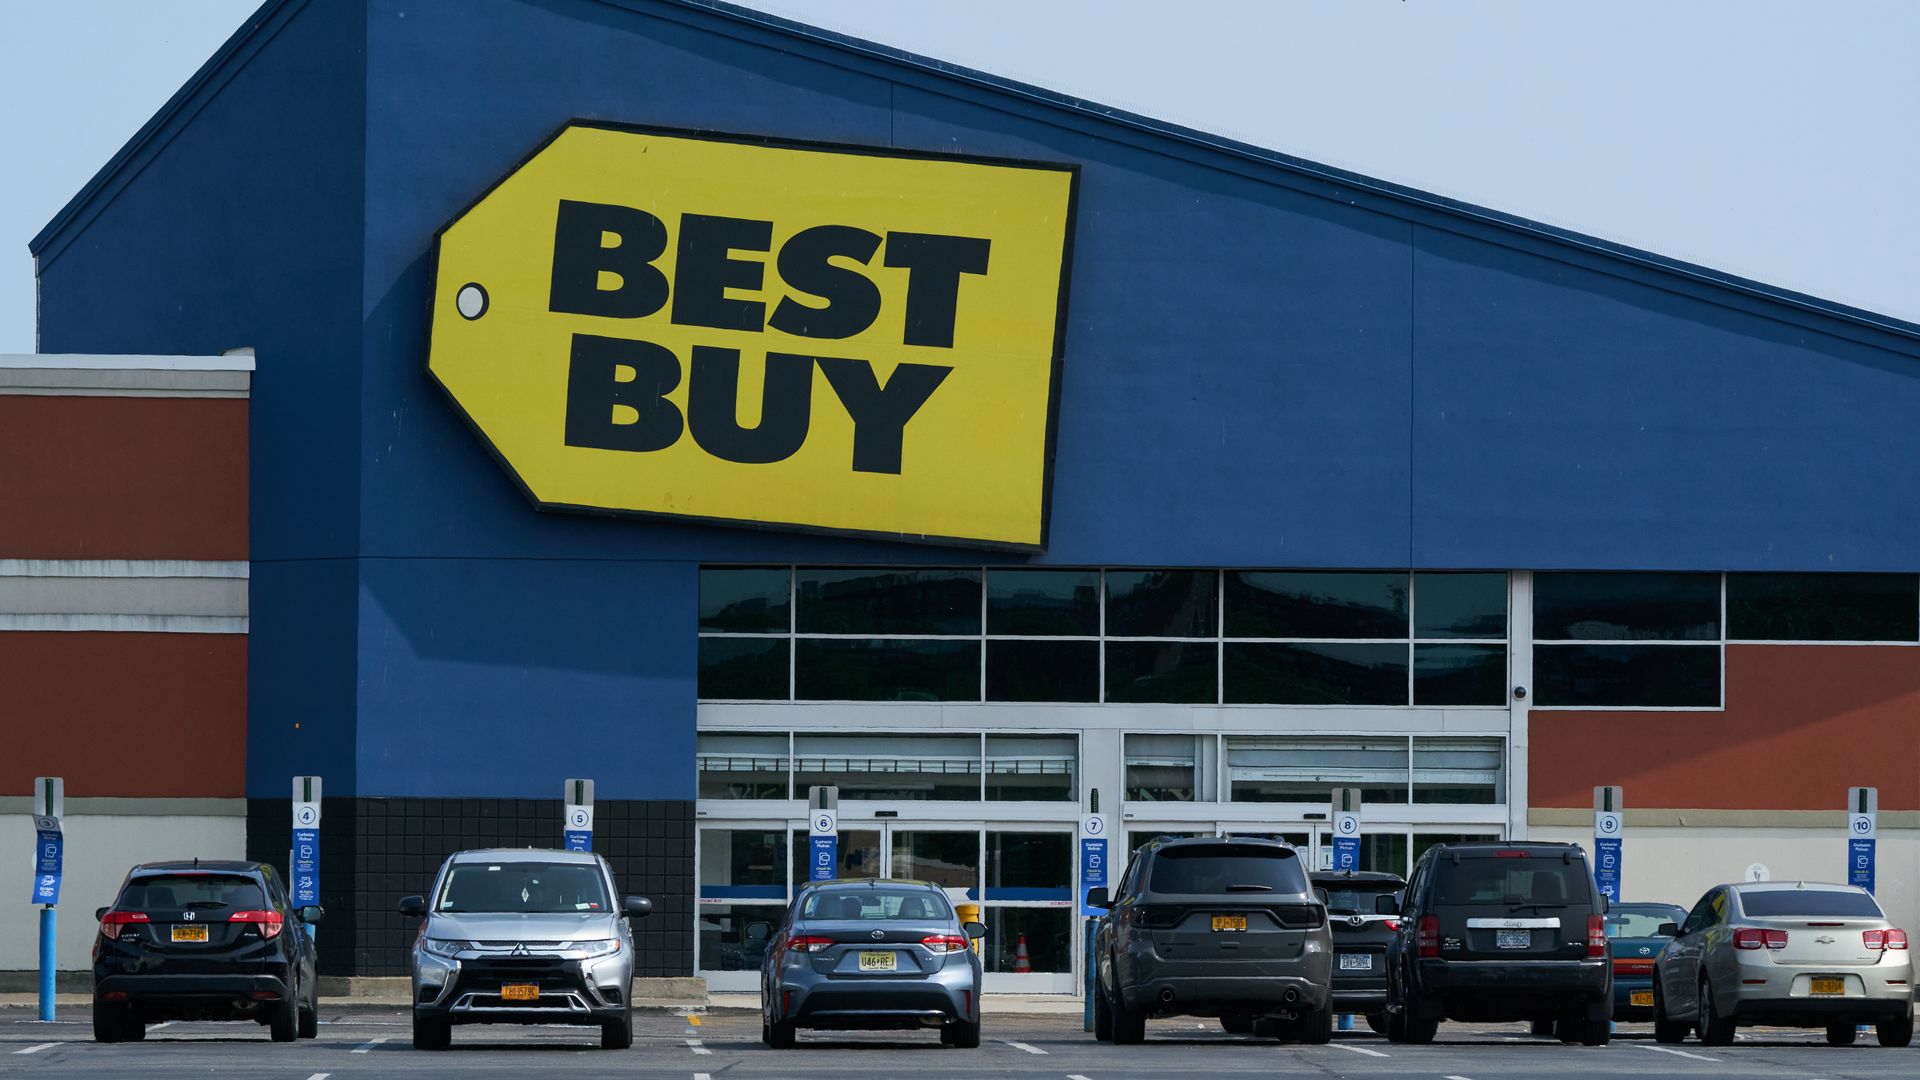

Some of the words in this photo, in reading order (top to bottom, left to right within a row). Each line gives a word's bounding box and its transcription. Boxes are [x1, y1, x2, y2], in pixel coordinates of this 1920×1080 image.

[549, 199, 991, 348] BEST
[564, 333, 955, 475] BUY
[303, 812, 310, 820] 4
[820, 819, 827, 827] 6
[1091, 822, 1097, 830] 7
[1344, 821, 1351, 829] 8
[1605, 820, 1612, 829] 9
[1856, 821, 1868, 830] 10
